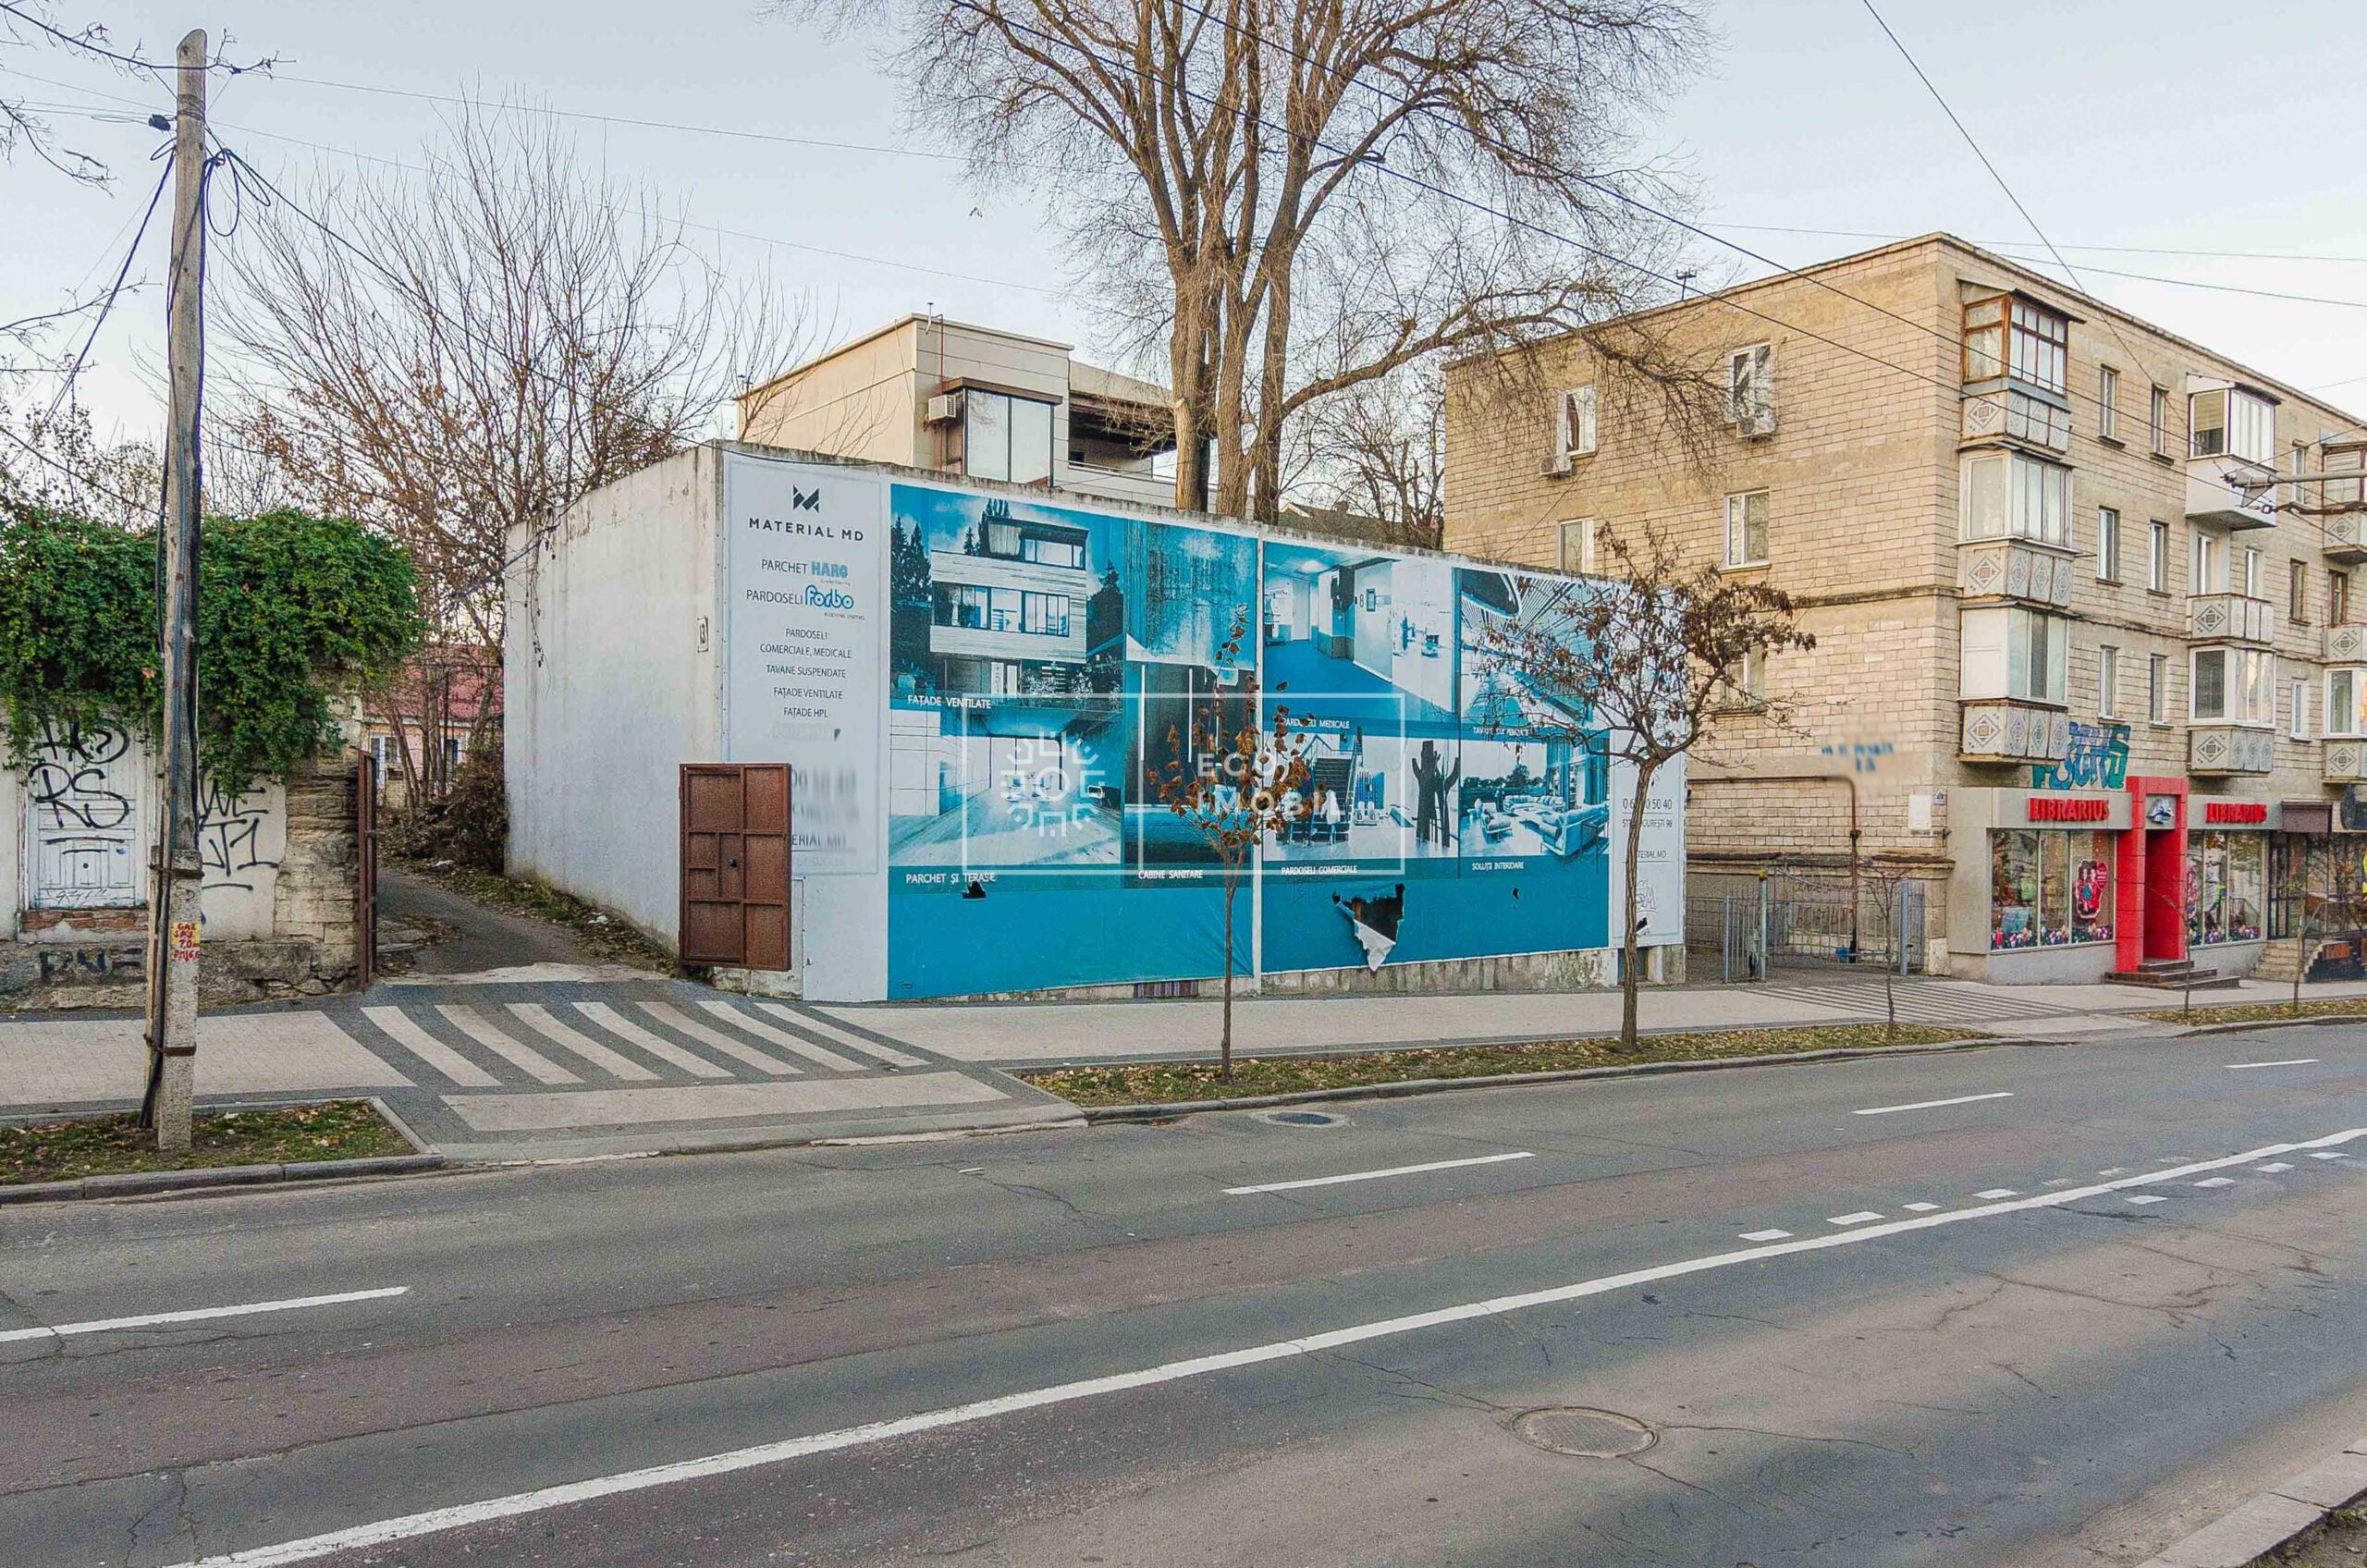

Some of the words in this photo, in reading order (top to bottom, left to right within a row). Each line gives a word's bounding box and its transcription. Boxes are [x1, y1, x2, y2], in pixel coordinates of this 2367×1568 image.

[748, 518, 834, 538] MATERIAL
[841, 529, 864, 541] MD
[761, 558, 808, 574] PARCHET
[811, 561, 848, 578] HARO
[746, 589, 803, 605] PARDOSELI
[785, 629, 828, 640] PARDOSELI
[813, 647, 852, 658] MEDICALE
[767, 665, 795, 675] TAVANE
[797, 667, 846, 678] SUSPENDATE
[803, 689, 843, 699] VENTILATE
[946, 697, 991, 709] VENTILATE
[814, 709, 828, 718] HPL
[1319, 720, 1350, 729] MEDICALE
[1652, 799, 1661, 809] 50
[1662, 799, 1672, 810] 40
[2030, 798, 2110, 821] LIBRARIUS
[2205, 802, 2267, 823] LIBRARIUS
[1138, 870, 1166, 879] CABINE
[1169, 870, 1204, 879] SANITARE
[1282, 866, 1316, 876] PARDOSELI
[1318, 865, 1357, 875] COMERCIALE
[906, 873, 947, 884] PARCHET
